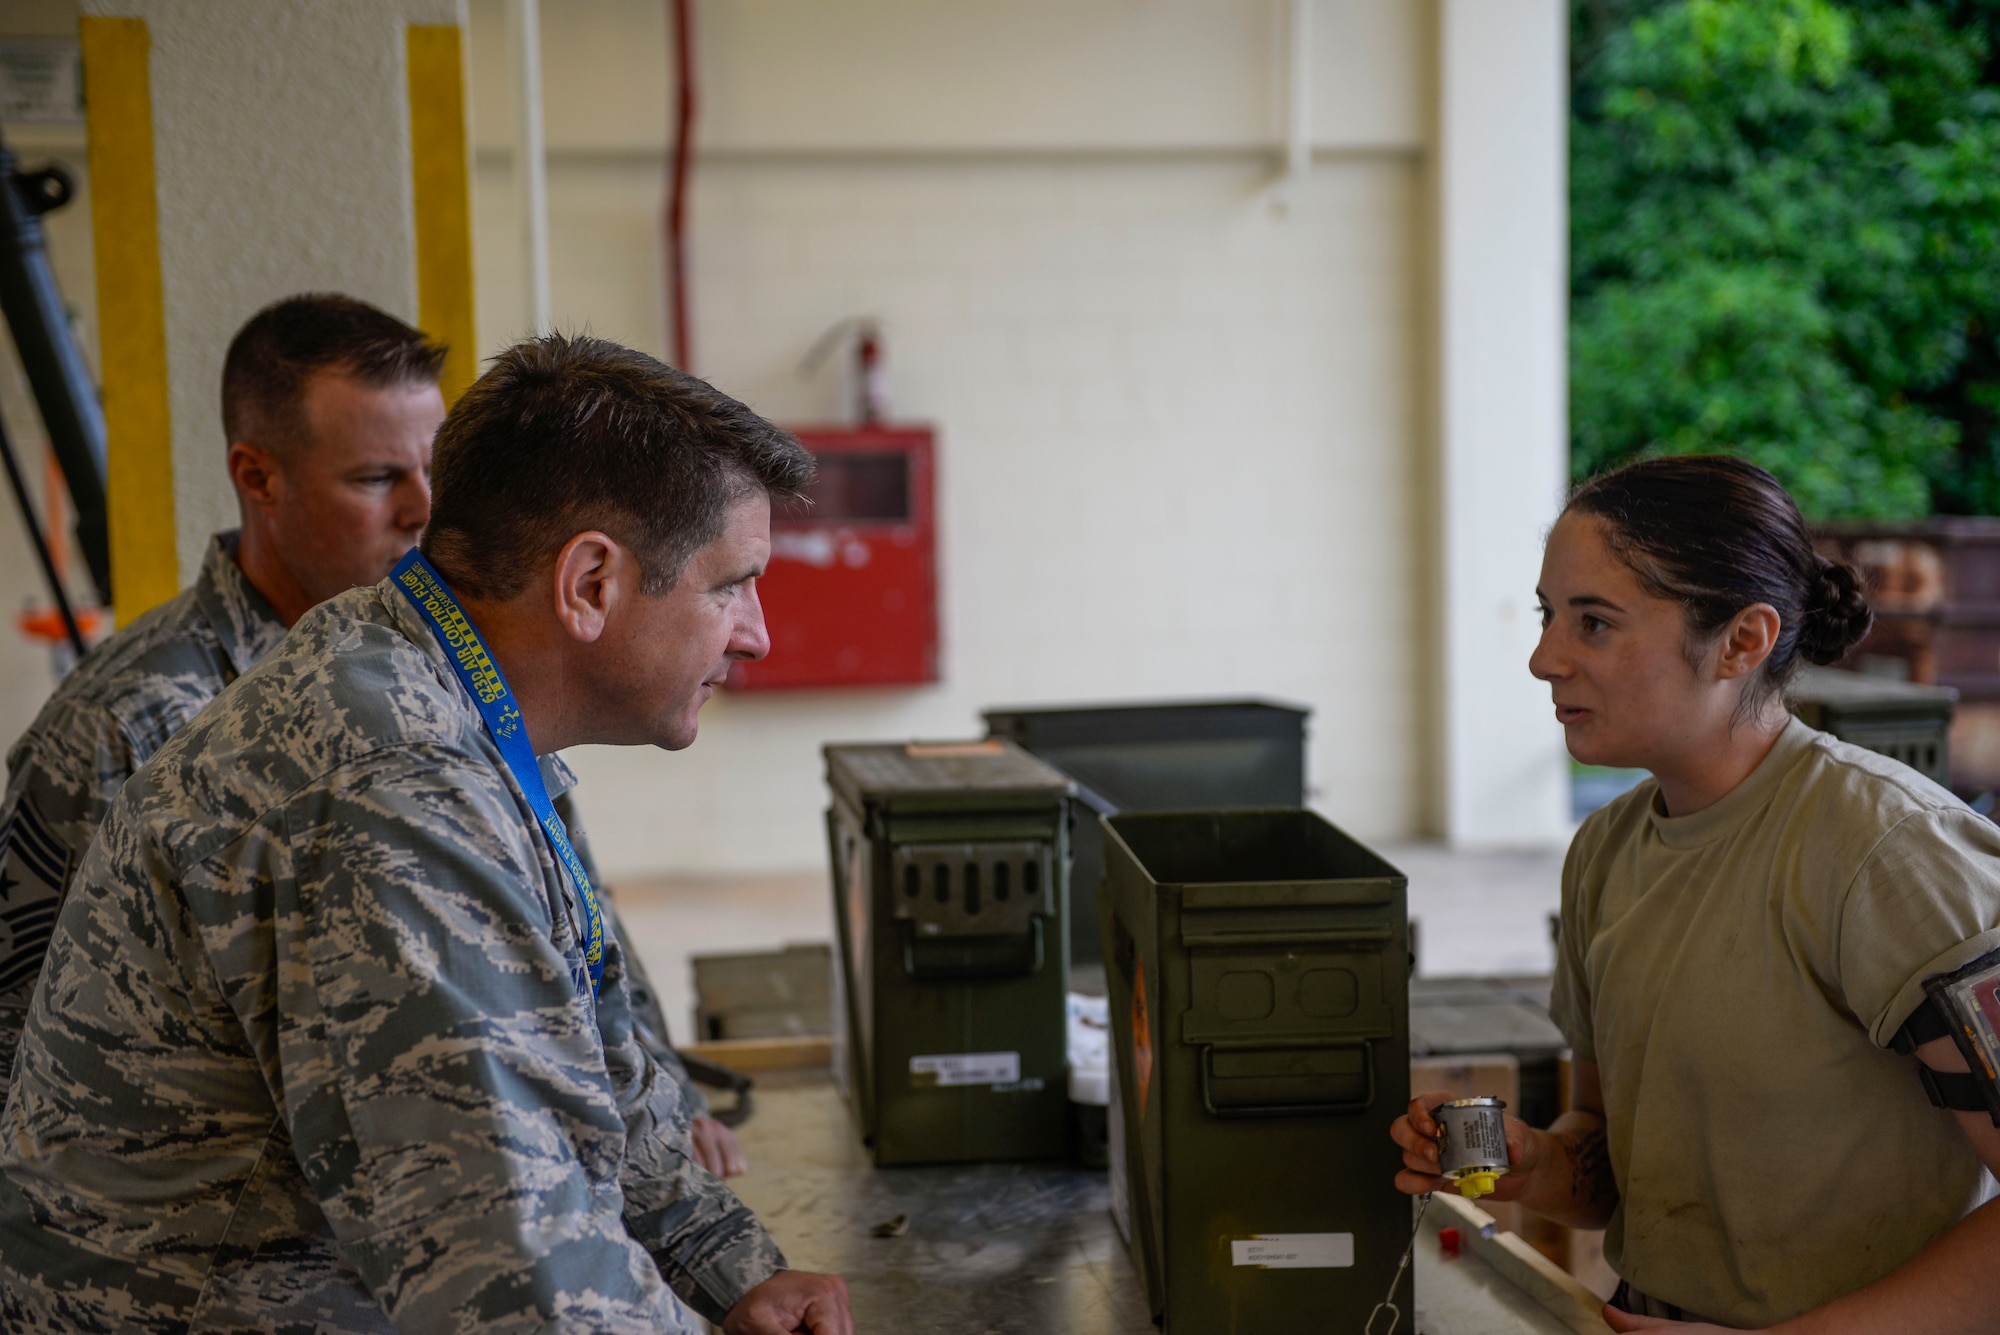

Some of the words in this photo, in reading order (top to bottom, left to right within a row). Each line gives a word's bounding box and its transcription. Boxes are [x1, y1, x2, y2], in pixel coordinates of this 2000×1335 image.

[399, 569, 430, 599] FLIGHT
[430, 584, 453, 607] SEMPER
[422, 595, 464, 648] CONTROL
[456, 646, 478, 671] AIR
[544, 818, 570, 860] FLIGHT
